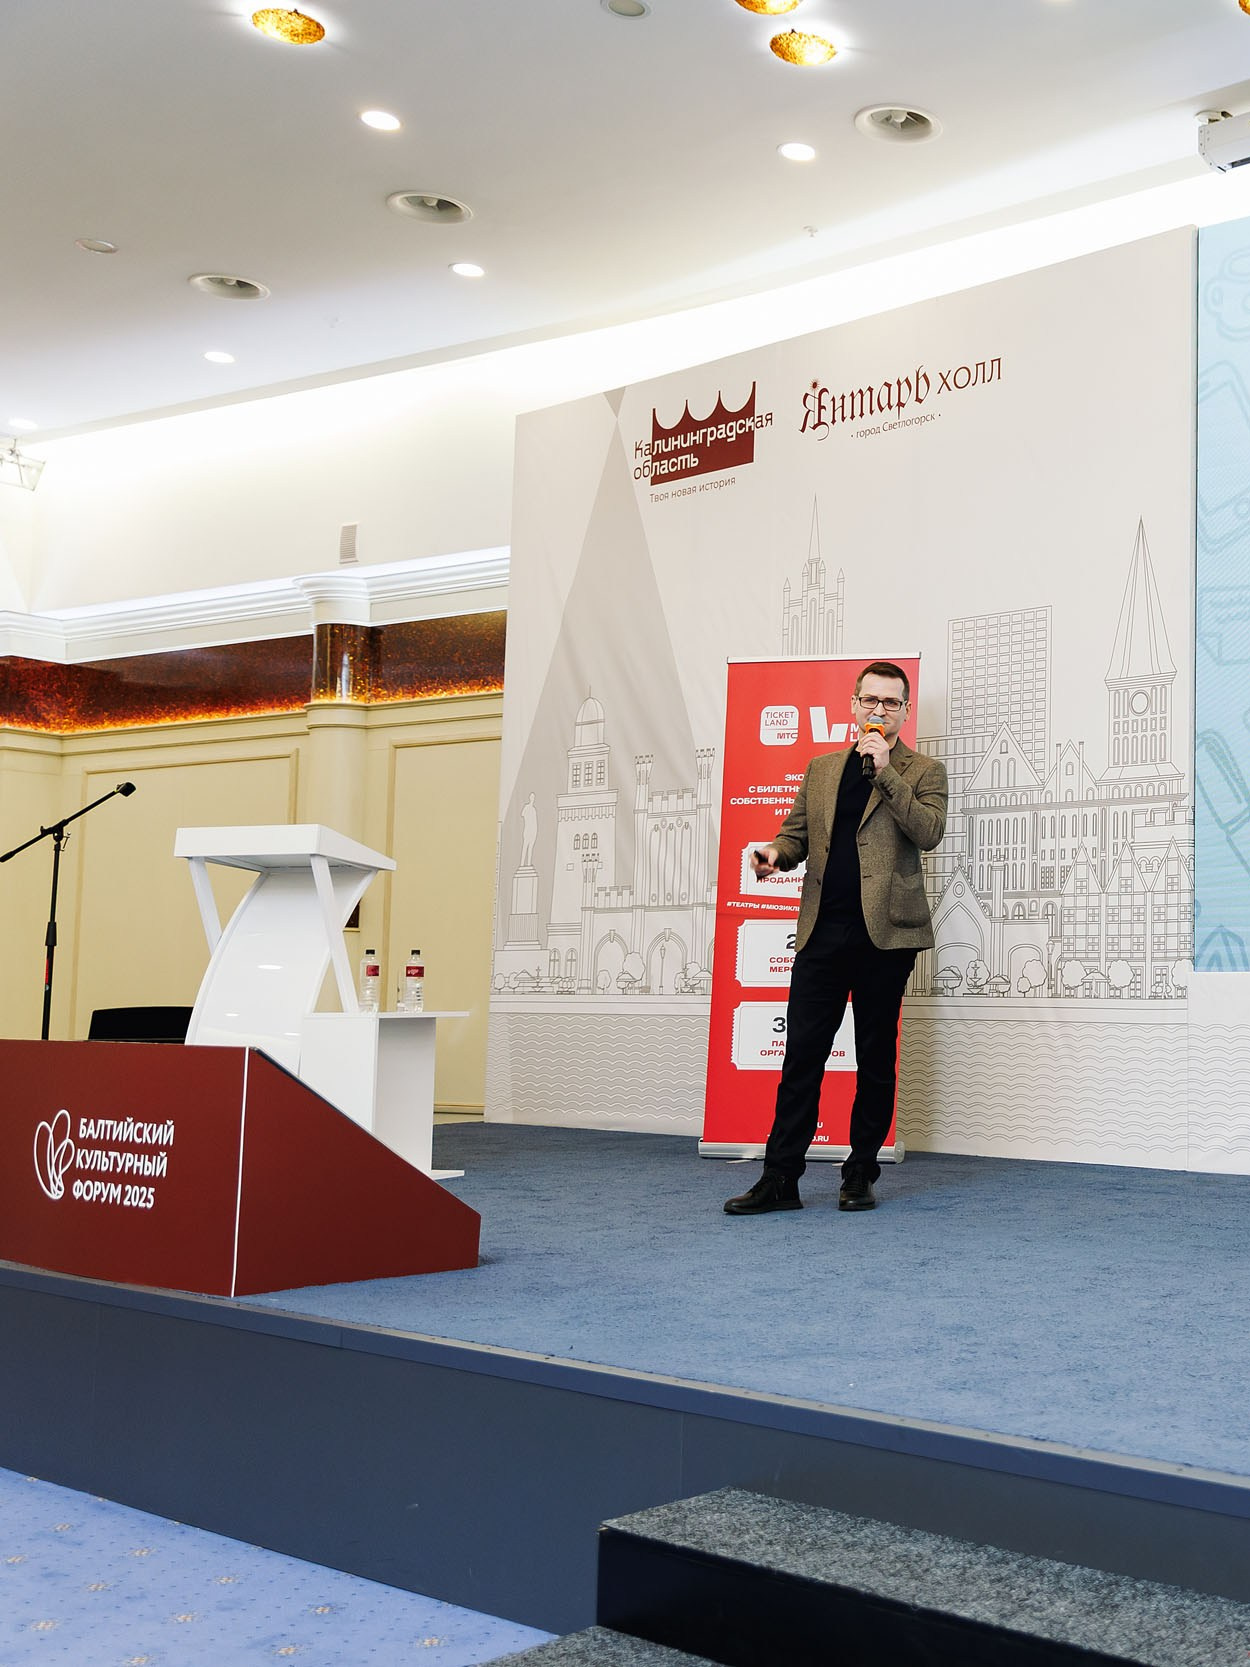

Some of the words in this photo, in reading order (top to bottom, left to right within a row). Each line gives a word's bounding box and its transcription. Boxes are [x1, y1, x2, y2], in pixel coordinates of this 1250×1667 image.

[799, 365, 931, 441] Янтарь
[634, 412, 774, 460] Калининградская
[855, 426, 881, 440] город
[881, 412, 937, 433] Светлогорск
[633, 452, 700, 481] область
[649, 492, 670, 504] Твоя
[671, 485, 697, 499] новая
[699, 476, 737, 492] история
[764, 719, 789, 727] LAND
[765, 711, 795, 719] TICKET
[756, 876, 804, 885] ПРОДАНН
[78, 1116, 175, 1147] БАЛТИЙСКИЙ
[75, 1148, 168, 1178] КУЛЬТУРНЫЙ
[72, 1179, 122, 1205] ФОРУМ
[123, 1184, 155, 1209] 2025
